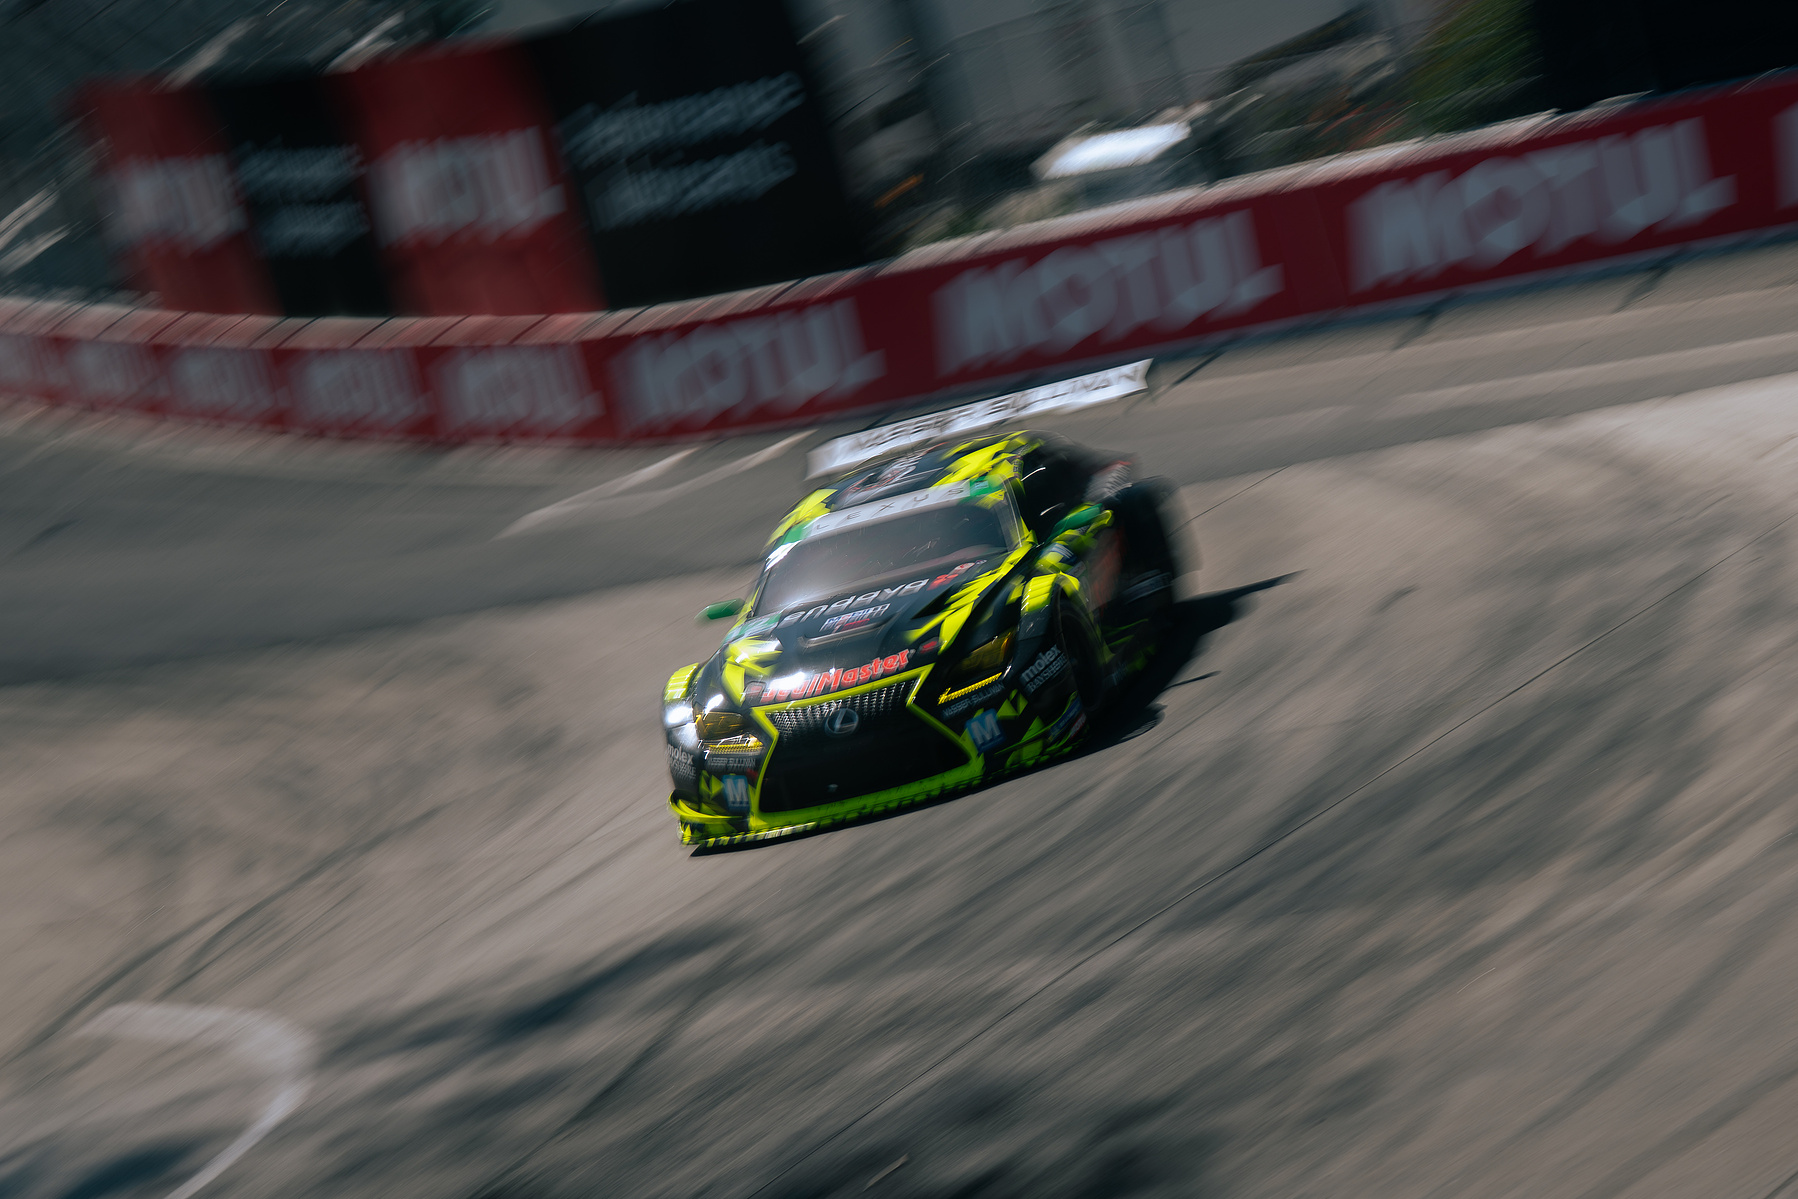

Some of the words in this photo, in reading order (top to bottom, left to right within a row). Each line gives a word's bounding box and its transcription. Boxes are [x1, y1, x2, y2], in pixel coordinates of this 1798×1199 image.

[1345, 118, 1738, 295] MOTUL
[932, 208, 1286, 378] MOTUL
[612, 297, 888, 434] MOTUL
[813, 483, 966, 532] LEXUS
[1018, 643, 1063, 686] molex
[969, 712, 1002, 746] M
[724, 778, 750, 802] M
